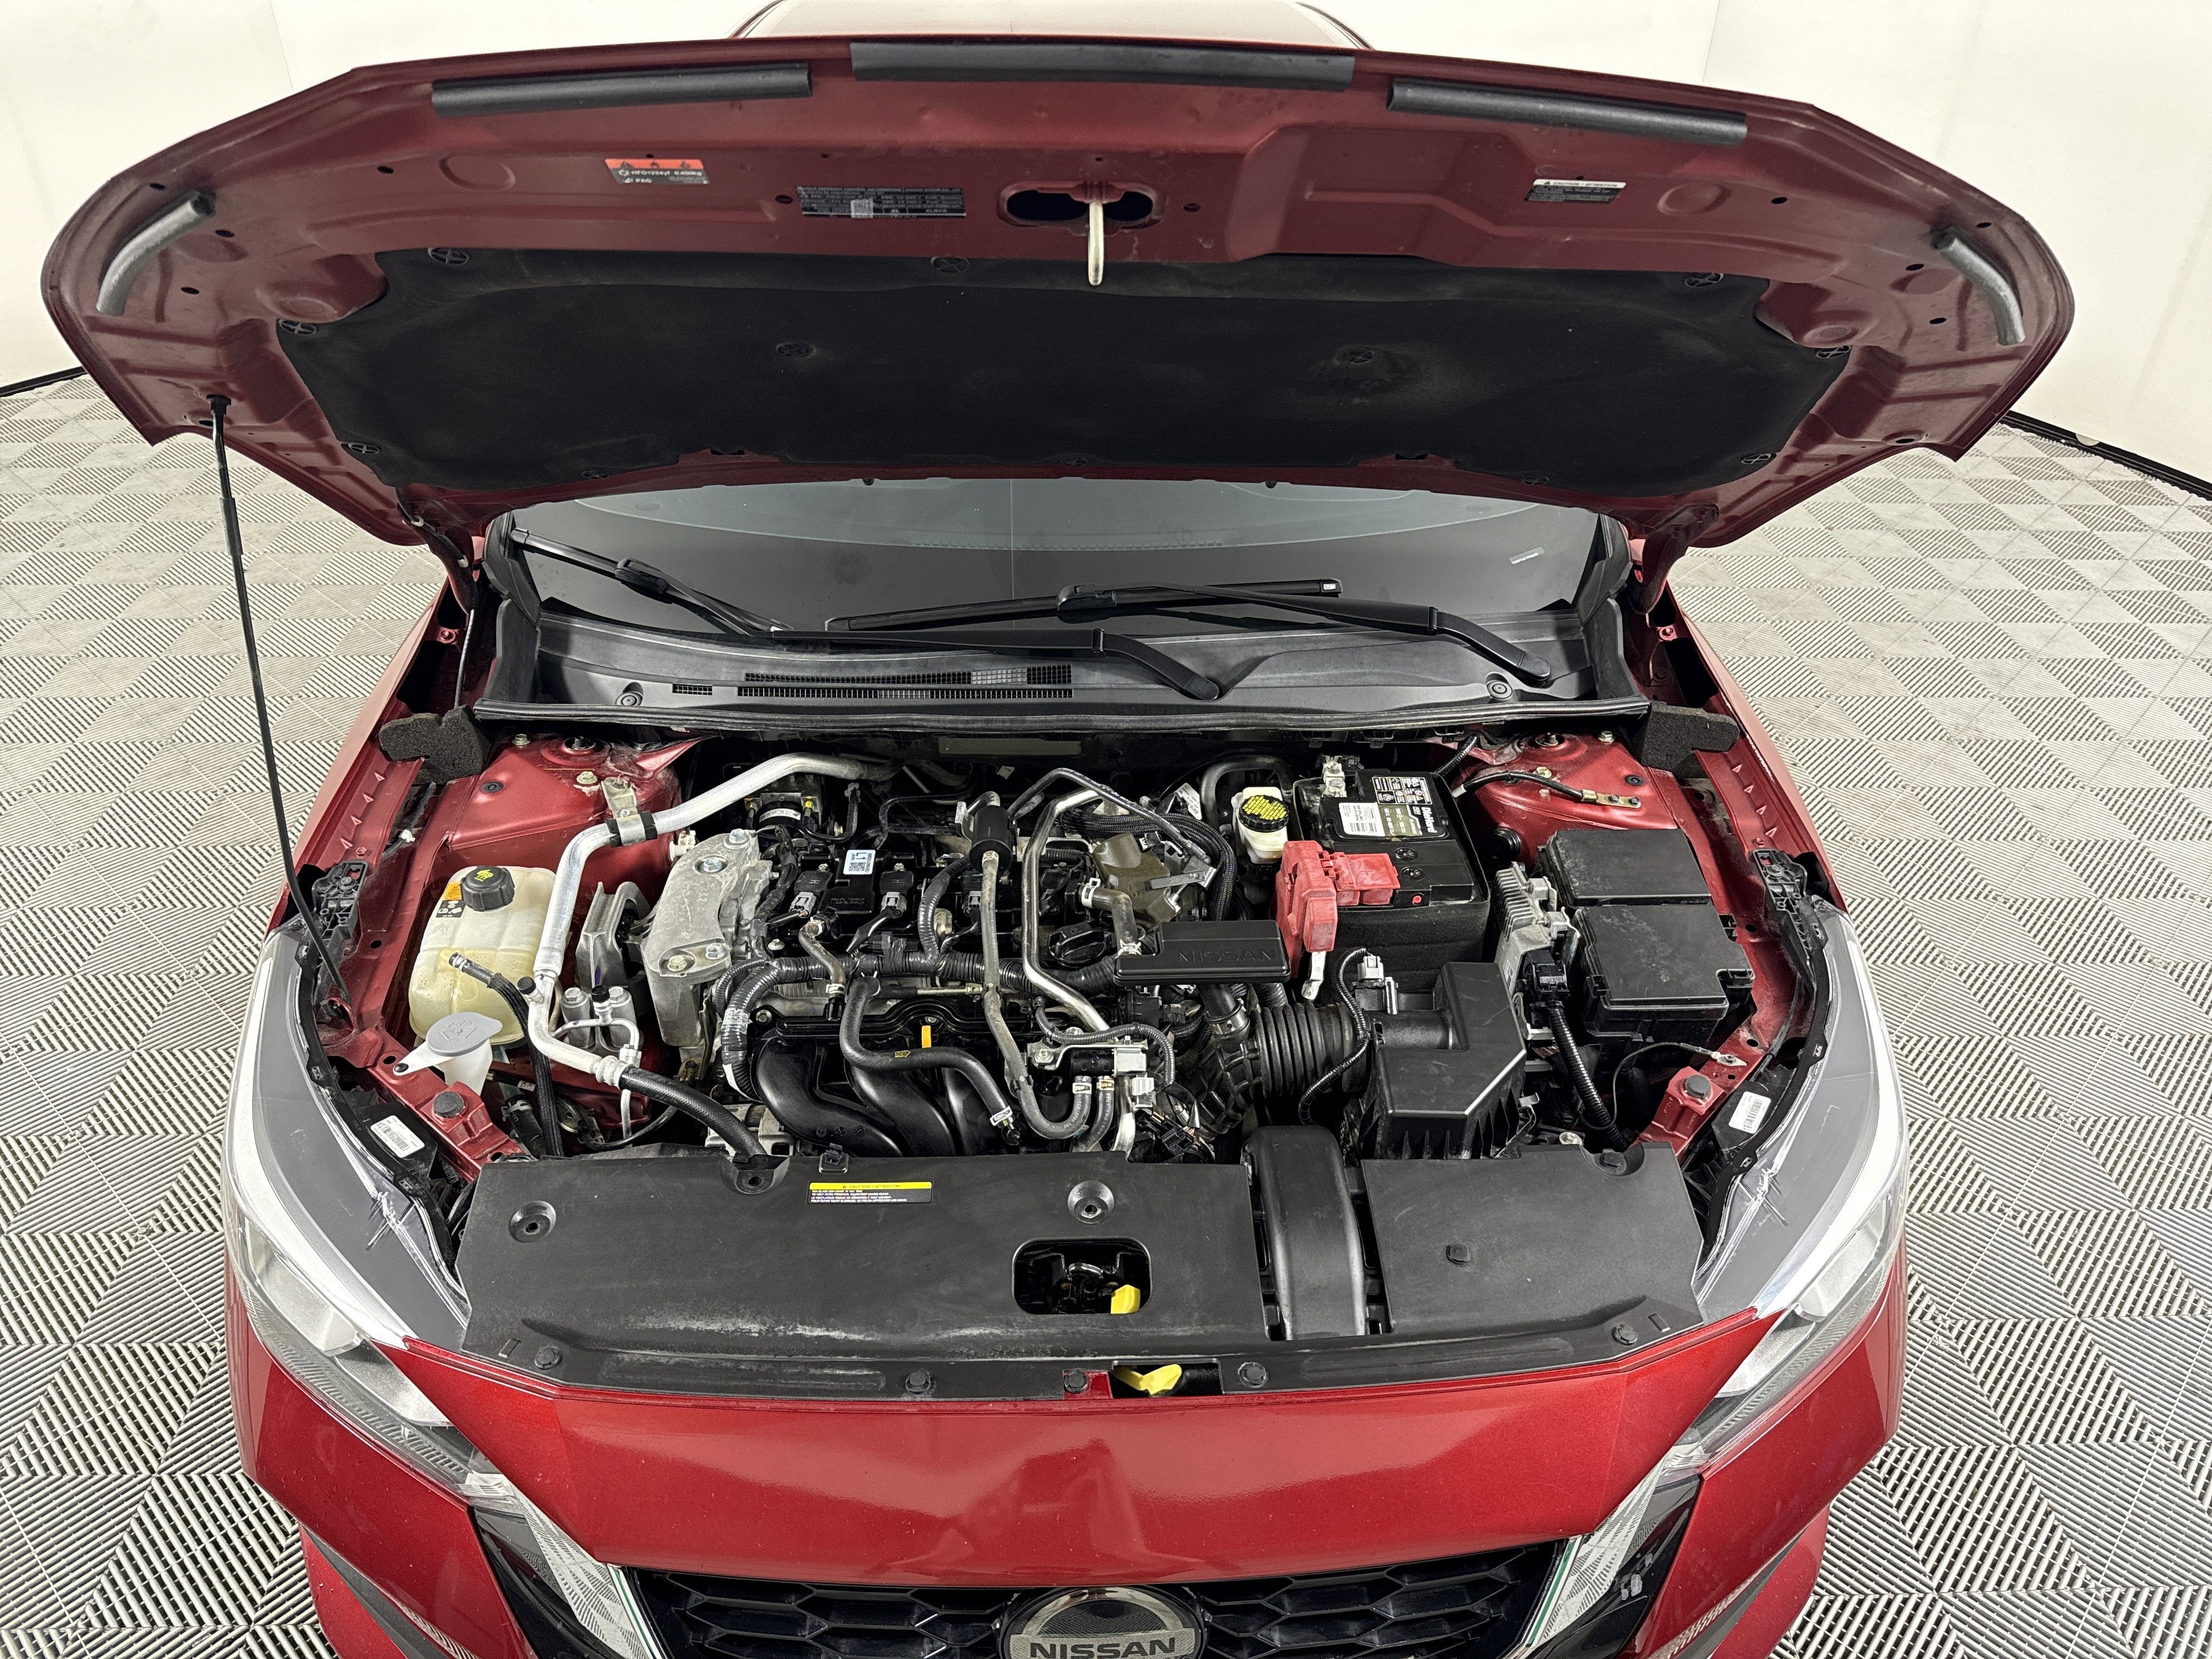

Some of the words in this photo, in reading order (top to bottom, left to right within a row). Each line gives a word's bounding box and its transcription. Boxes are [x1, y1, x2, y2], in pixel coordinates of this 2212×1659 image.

[1421, 806, 1437, 833] DieHard
[1175, 949, 1278, 963] NISSAN
[1030, 1637, 1176, 1659] NISSAN
